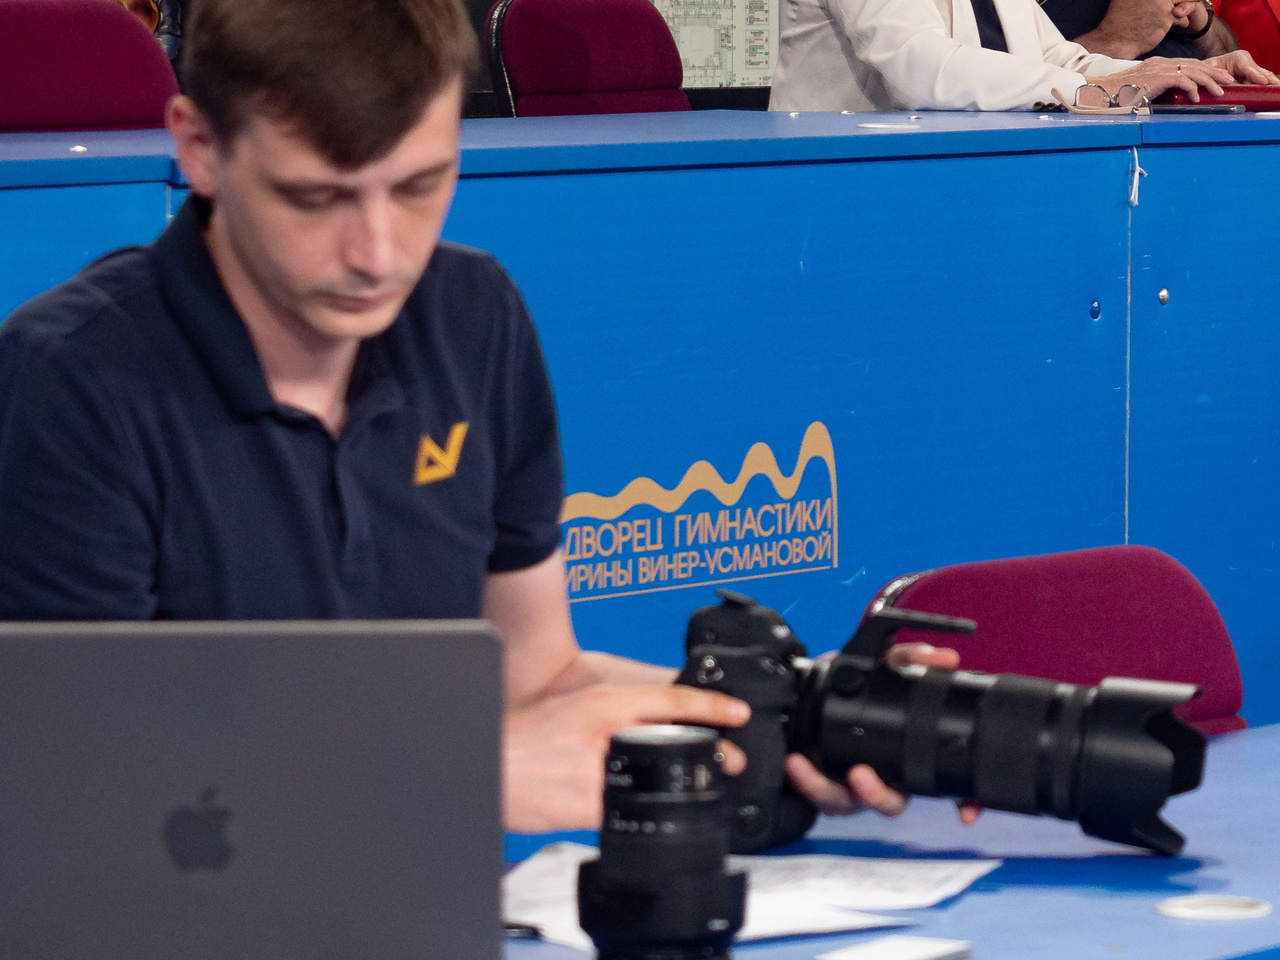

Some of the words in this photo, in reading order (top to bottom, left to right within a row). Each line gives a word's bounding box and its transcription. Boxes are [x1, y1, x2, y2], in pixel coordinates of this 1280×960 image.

[564, 518, 664, 561] ДВОРЕЦ
[674, 498, 832, 547] ГИМНАСТИКИ
[565, 560, 633, 592] ИРИНЫ
[638, 532, 832, 584] ВИНЕР-УСМАНОВОЙ
